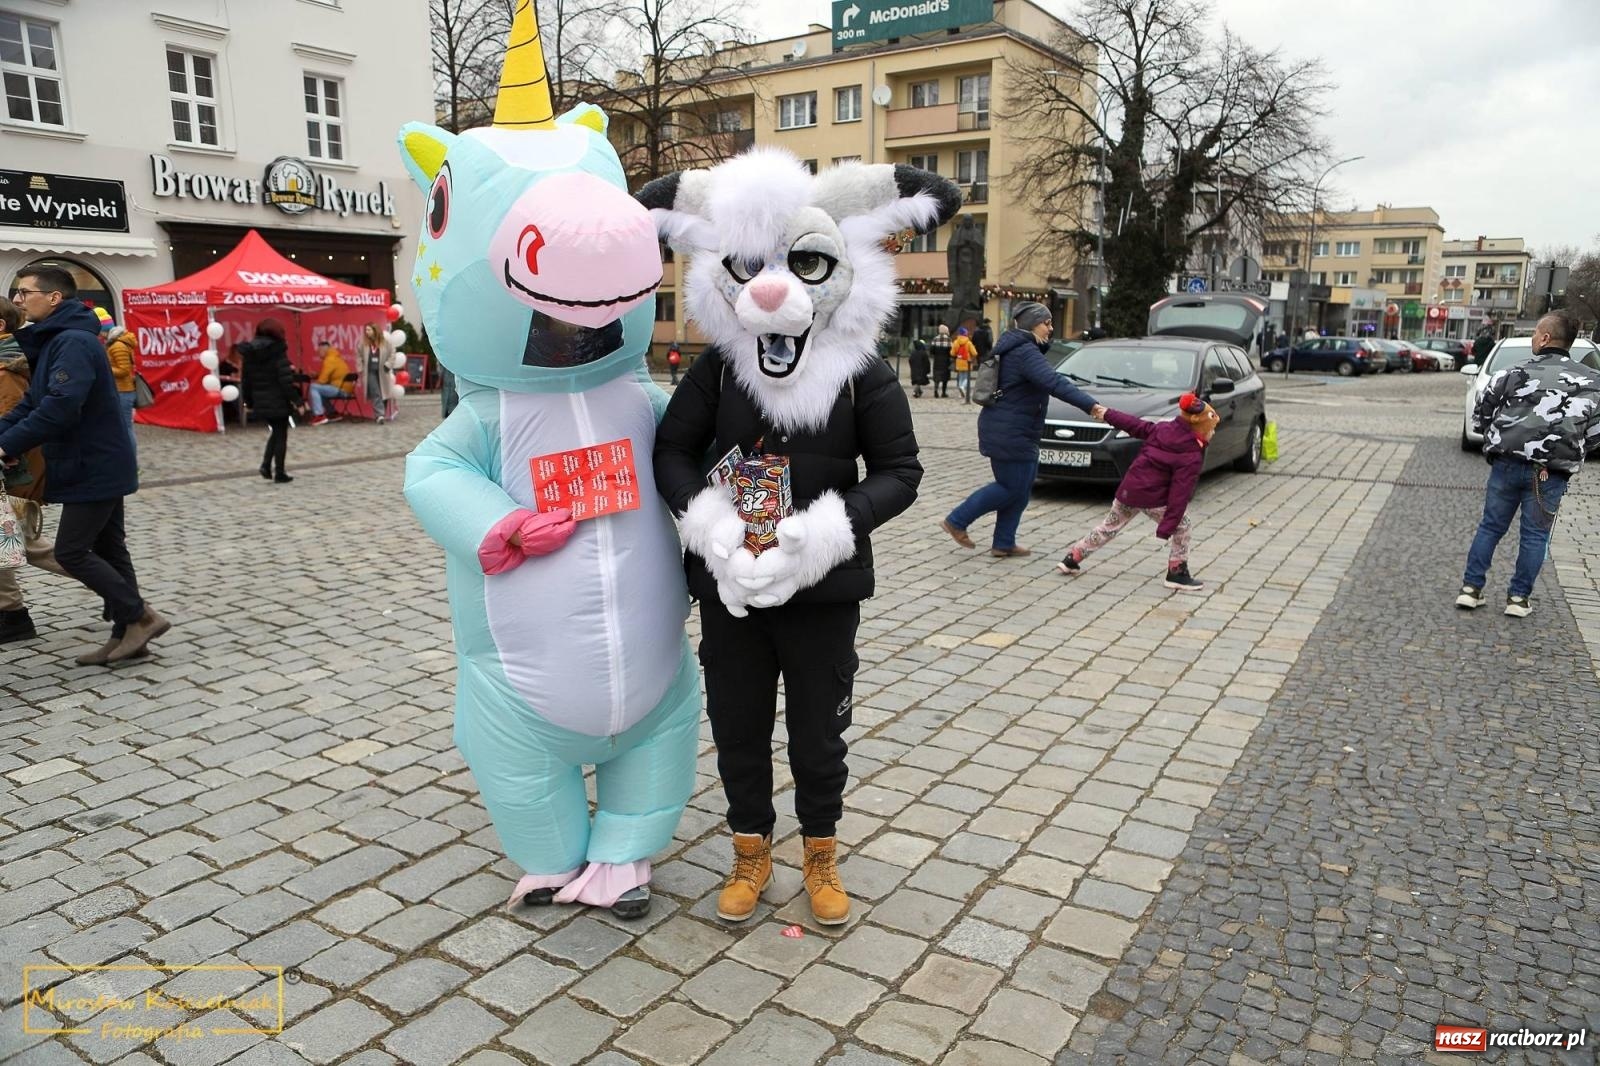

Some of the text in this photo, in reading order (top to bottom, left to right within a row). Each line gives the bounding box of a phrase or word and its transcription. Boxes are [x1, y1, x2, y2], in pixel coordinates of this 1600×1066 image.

[837, 28, 866, 41] 300 m
[150, 154, 397, 217] Browar Rynek
[25, 193, 118, 221] Wypieki
[237, 270, 310, 286] DKMS
[223, 291, 280, 304] Zostań
[138, 325, 186, 355] DKMS
[1040, 450, 1055, 461] SR
[742, 488, 770, 514] 32
